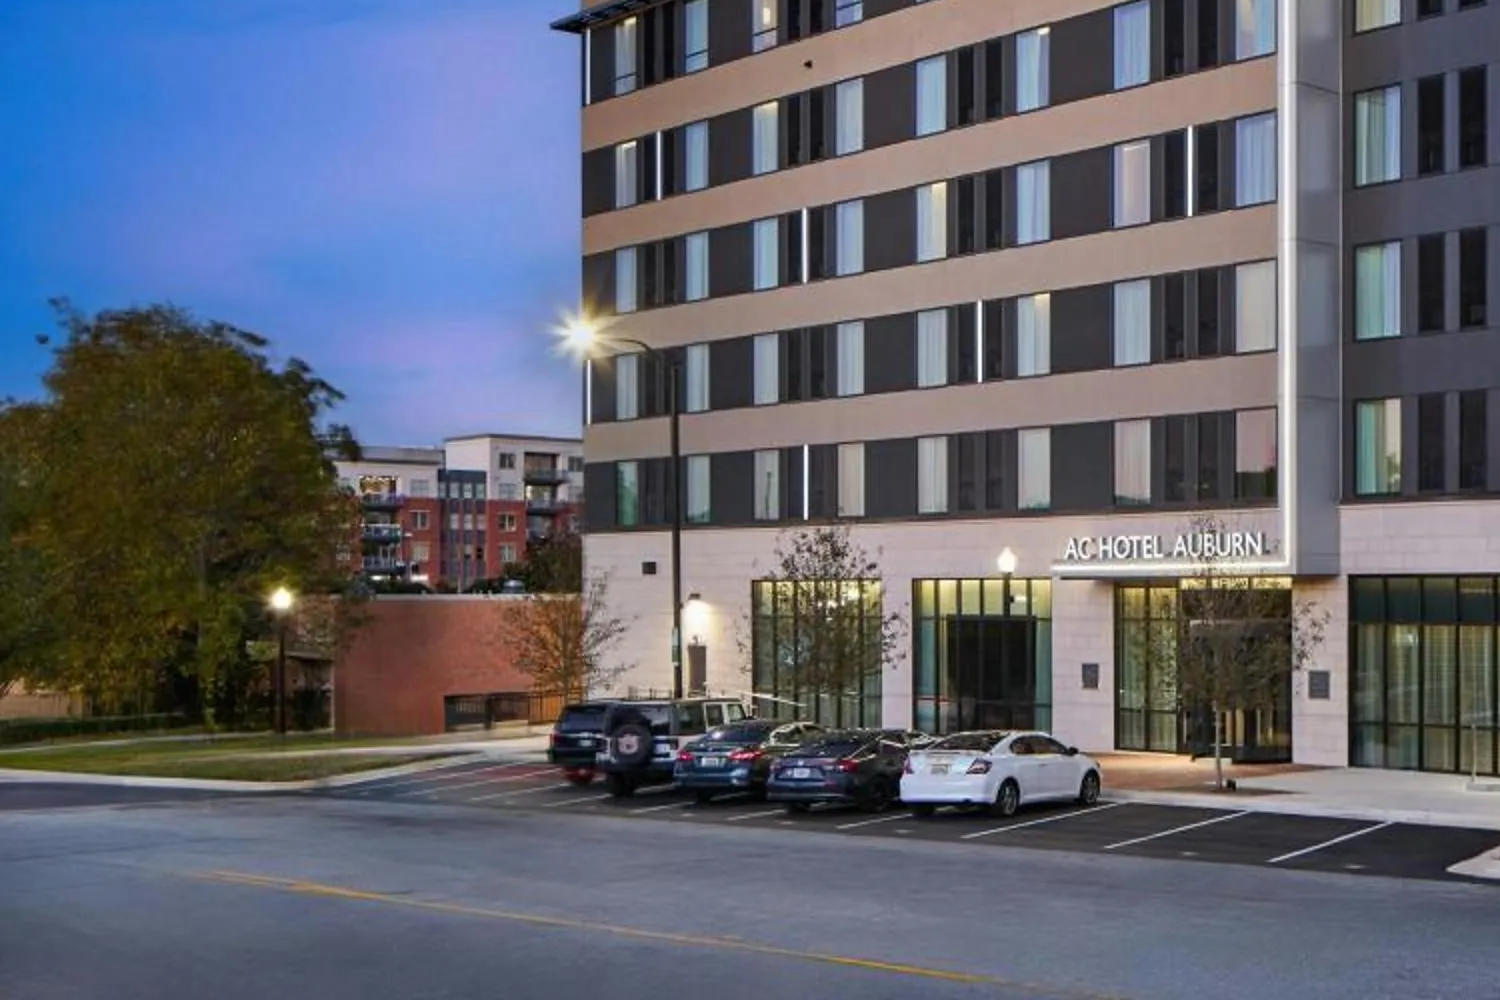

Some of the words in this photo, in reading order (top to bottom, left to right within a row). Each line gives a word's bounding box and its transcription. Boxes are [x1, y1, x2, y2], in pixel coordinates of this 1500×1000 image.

[1064, 537, 1092, 560] AC
[1098, 535, 1164, 559] HOTEL
[1173, 532, 1263, 558] AUBURN
